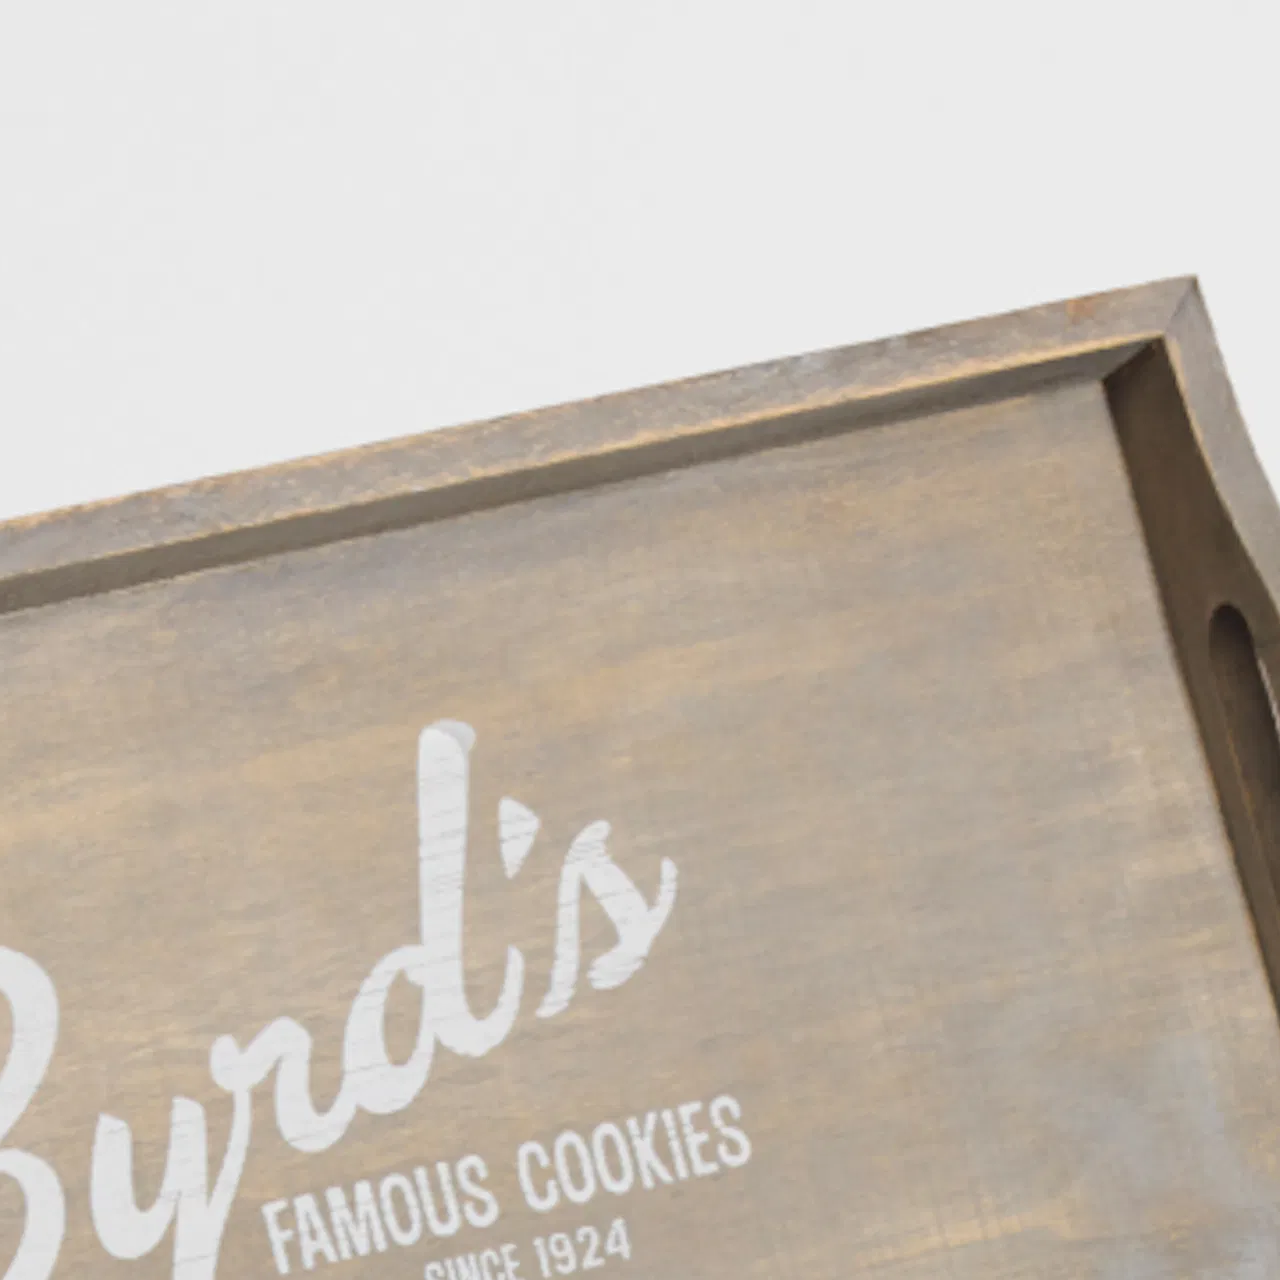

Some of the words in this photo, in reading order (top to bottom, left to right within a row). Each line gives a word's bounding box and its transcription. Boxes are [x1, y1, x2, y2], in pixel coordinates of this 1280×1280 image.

[260, 1153, 501, 1276] FAMOUS
[516, 1094, 753, 1214] COOKIES
[532, 1217, 632, 1280] 1924
